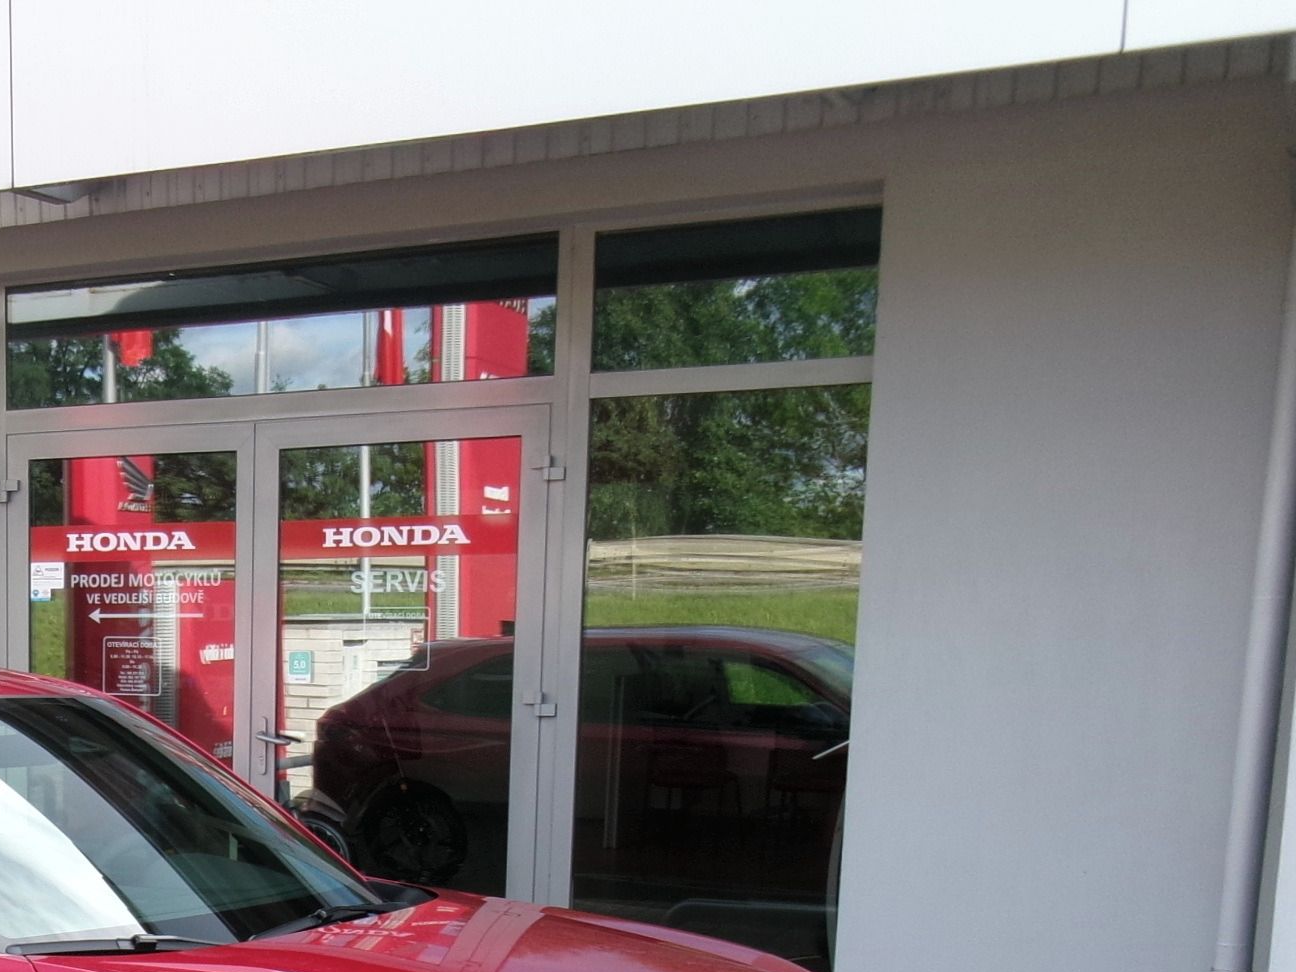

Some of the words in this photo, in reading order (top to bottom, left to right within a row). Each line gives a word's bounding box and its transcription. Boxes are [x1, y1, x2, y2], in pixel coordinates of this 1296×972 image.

[66, 531, 196, 552] HONDA
[322, 525, 471, 548] HONDA
[70, 573, 124, 588] PRODEJ
[128, 568, 222, 587] MOTOCYKLŮ
[350, 570, 446, 593] SERVIS
[86, 593, 101, 605] VE
[103, 590, 154, 605] VEDLEJŠÍ
[156, 590, 204, 604] BUDOVĚ
